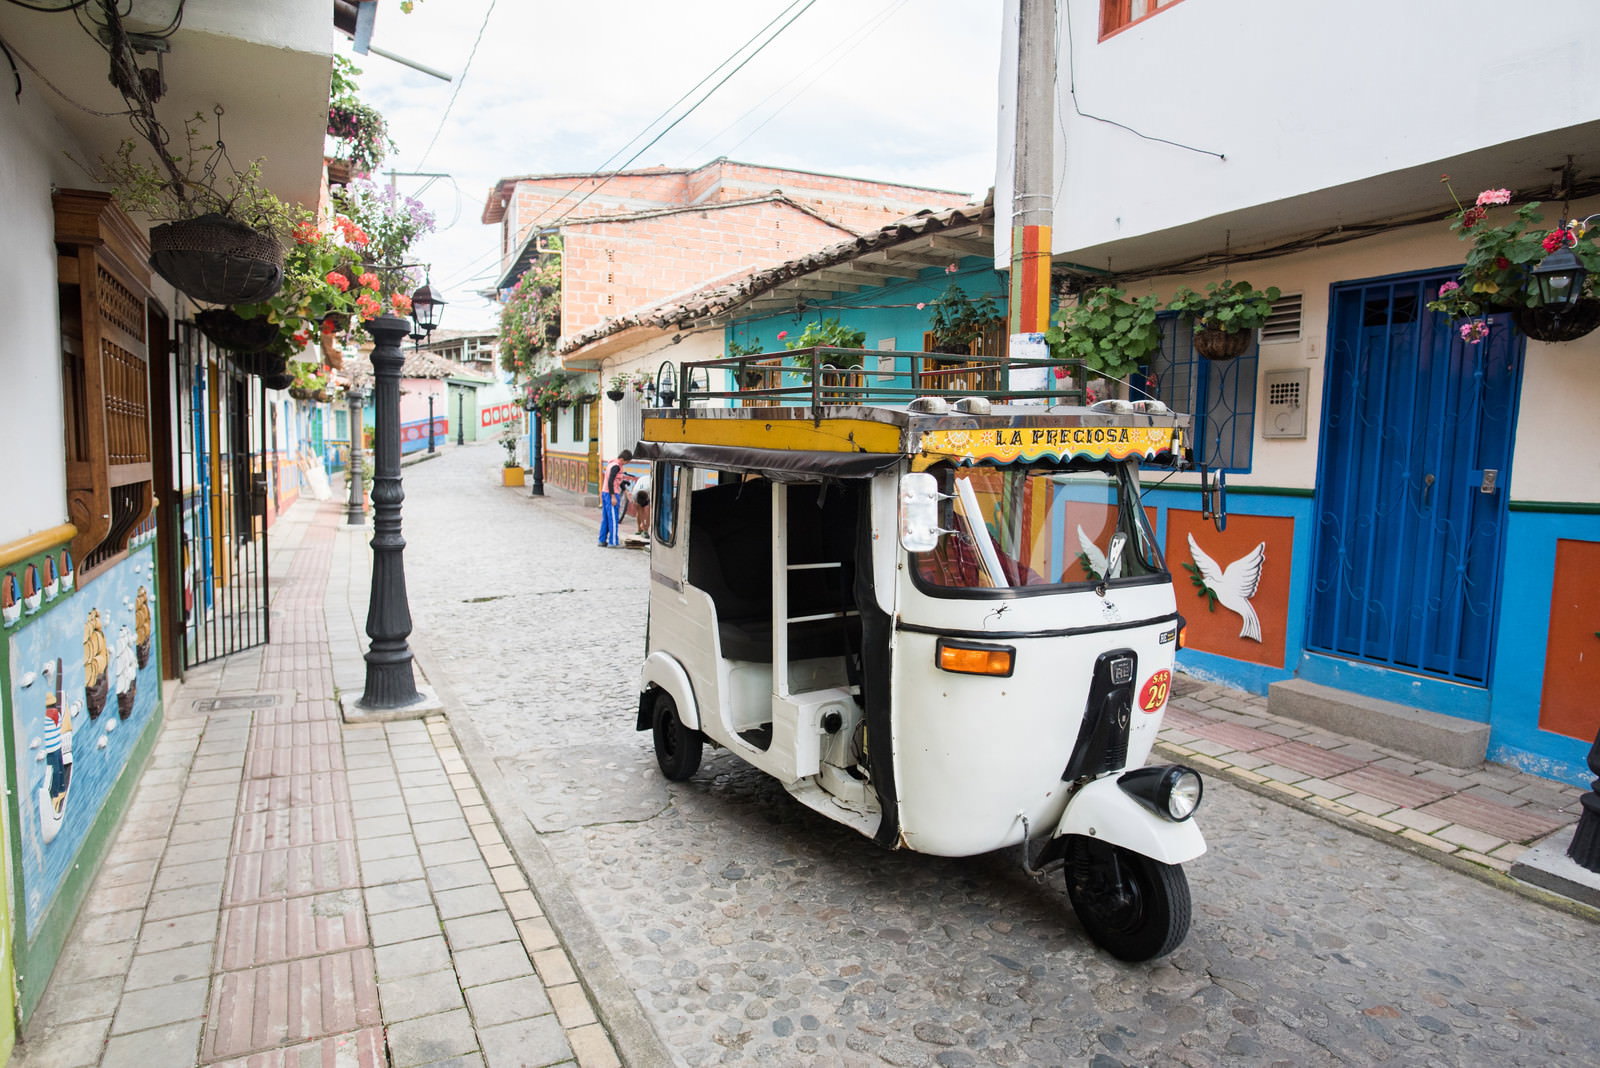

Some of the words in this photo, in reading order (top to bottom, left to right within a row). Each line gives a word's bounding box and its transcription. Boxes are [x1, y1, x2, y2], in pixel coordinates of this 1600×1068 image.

[995, 430, 1023, 446] LA
[1031, 428, 1130, 447] PRECIOSA
[1115, 667, 1129, 678] RE
[1152, 672, 1168, 684] SAS
[1144, 682, 1167, 710] 29
